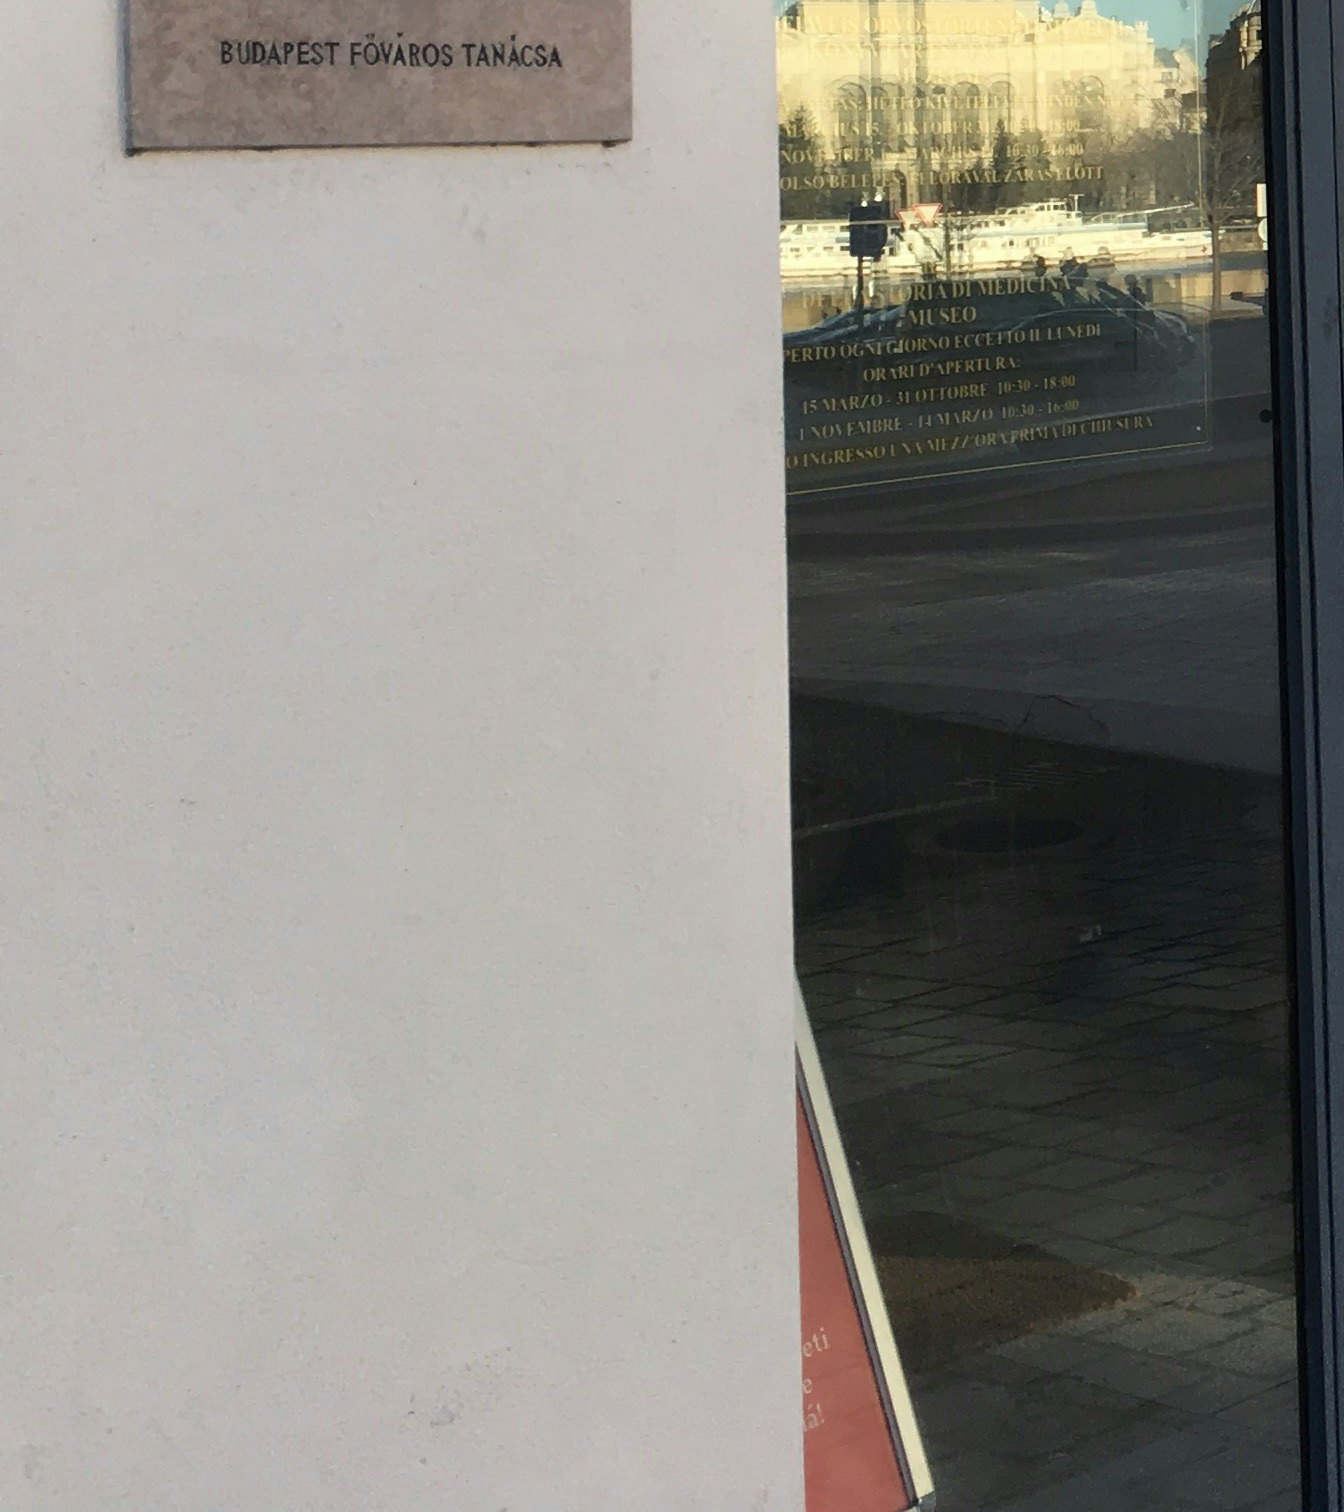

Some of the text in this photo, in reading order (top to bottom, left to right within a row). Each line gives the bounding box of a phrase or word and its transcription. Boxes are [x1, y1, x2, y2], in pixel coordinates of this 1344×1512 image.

[220, 40, 340, 68] BUDAPEST
[460, 32, 563, 70] TANÁCSA
[979, 274, 1070, 297] MEDICINA
[907, 305, 977, 327] MUSEO
[954, 329, 1026, 349] ECCETTO
[862, 363, 915, 384] ORARI
[801, 399, 818, 415] 15
[822, 394, 884, 412] MARZO
[896, 390, 911, 405] 31
[915, 383, 989, 403] OTTOBRE
[997, 378, 1032, 396] 10:30
[809, 417, 903, 439] NOVEMBRE
[937, 408, 993, 426] MARZO
[802, 445, 886, 467] INGRESSO
